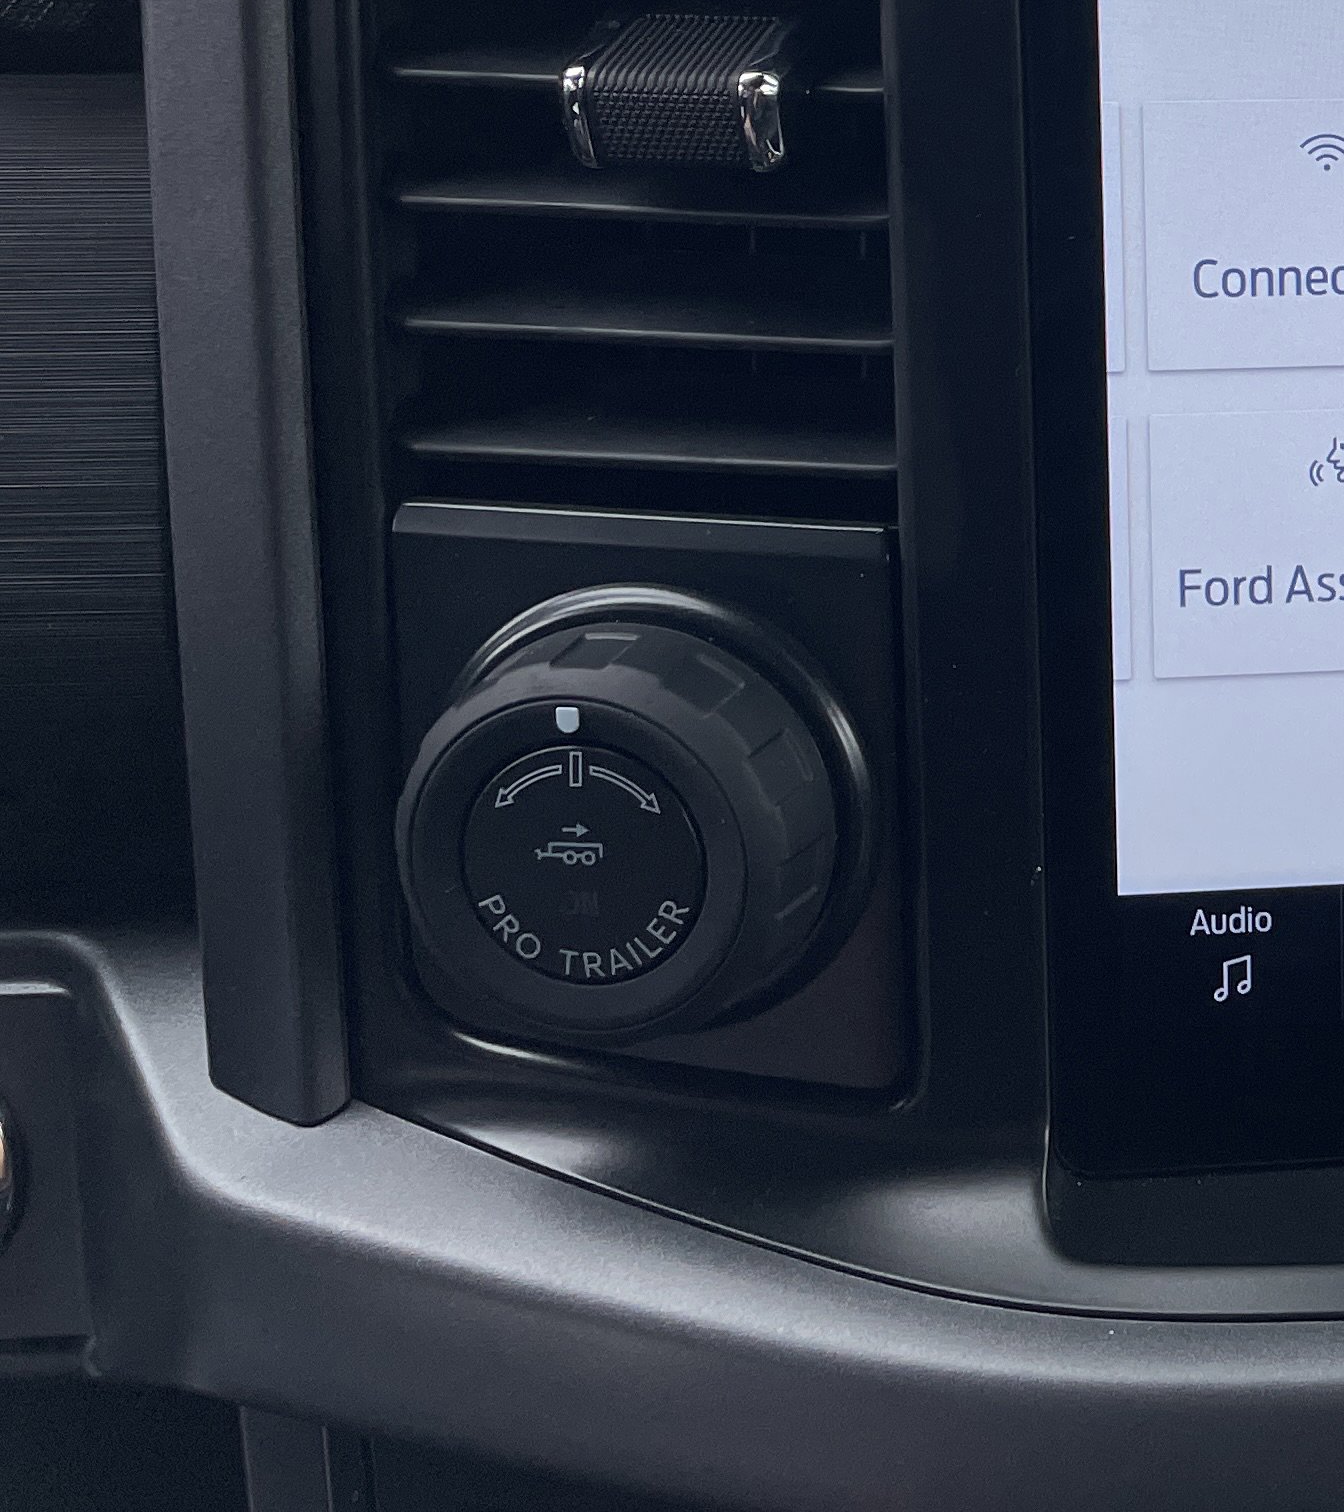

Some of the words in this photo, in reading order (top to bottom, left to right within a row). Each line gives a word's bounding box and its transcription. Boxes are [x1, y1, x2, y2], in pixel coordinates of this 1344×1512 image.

[1179, 564, 1273, 608] Ford
[478, 894, 542, 960] PRO
[559, 900, 690, 978] TRAILER
[1189, 905, 1272, 937] Audio
